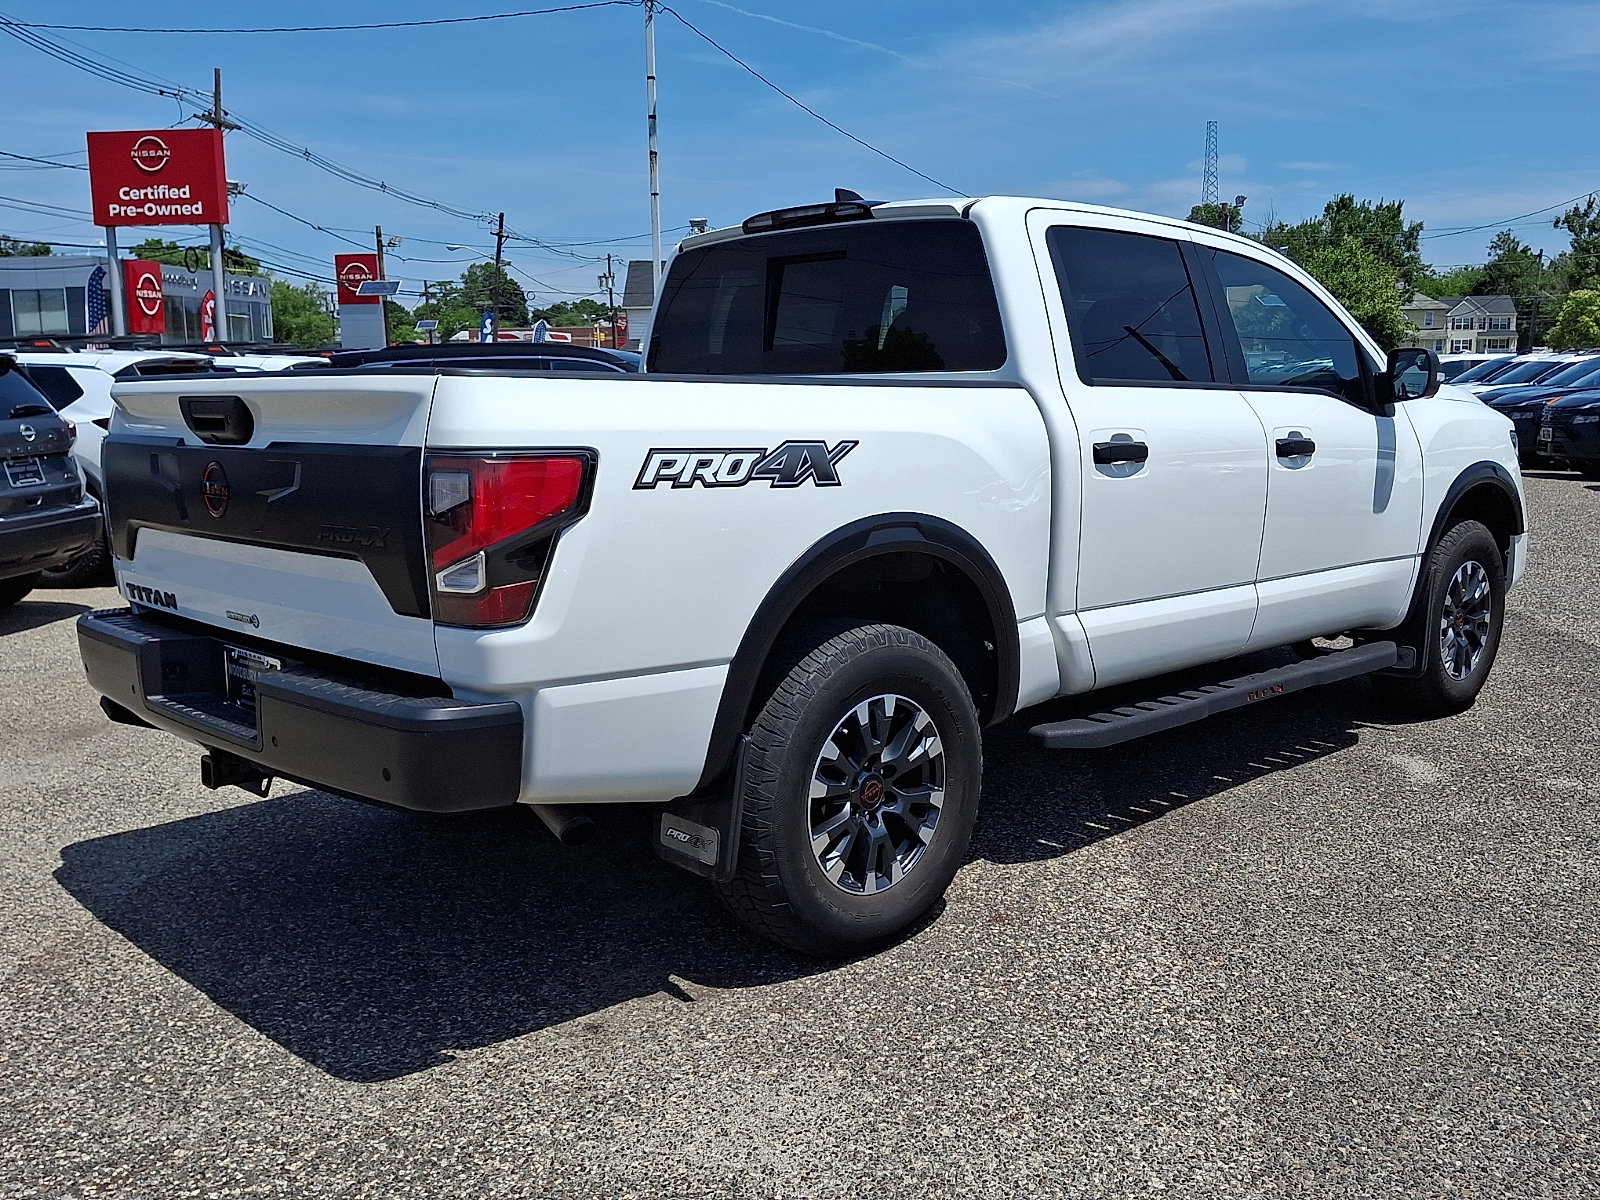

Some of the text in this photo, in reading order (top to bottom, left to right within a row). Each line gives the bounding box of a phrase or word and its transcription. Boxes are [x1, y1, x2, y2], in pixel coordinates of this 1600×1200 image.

[131, 149, 170, 157] NISSAN
[119, 184, 190, 200] Certified
[109, 201, 203, 217] Pre-Owned
[136, 289, 162, 299] NISSAN
[126, 582, 178, 610] TITAN
